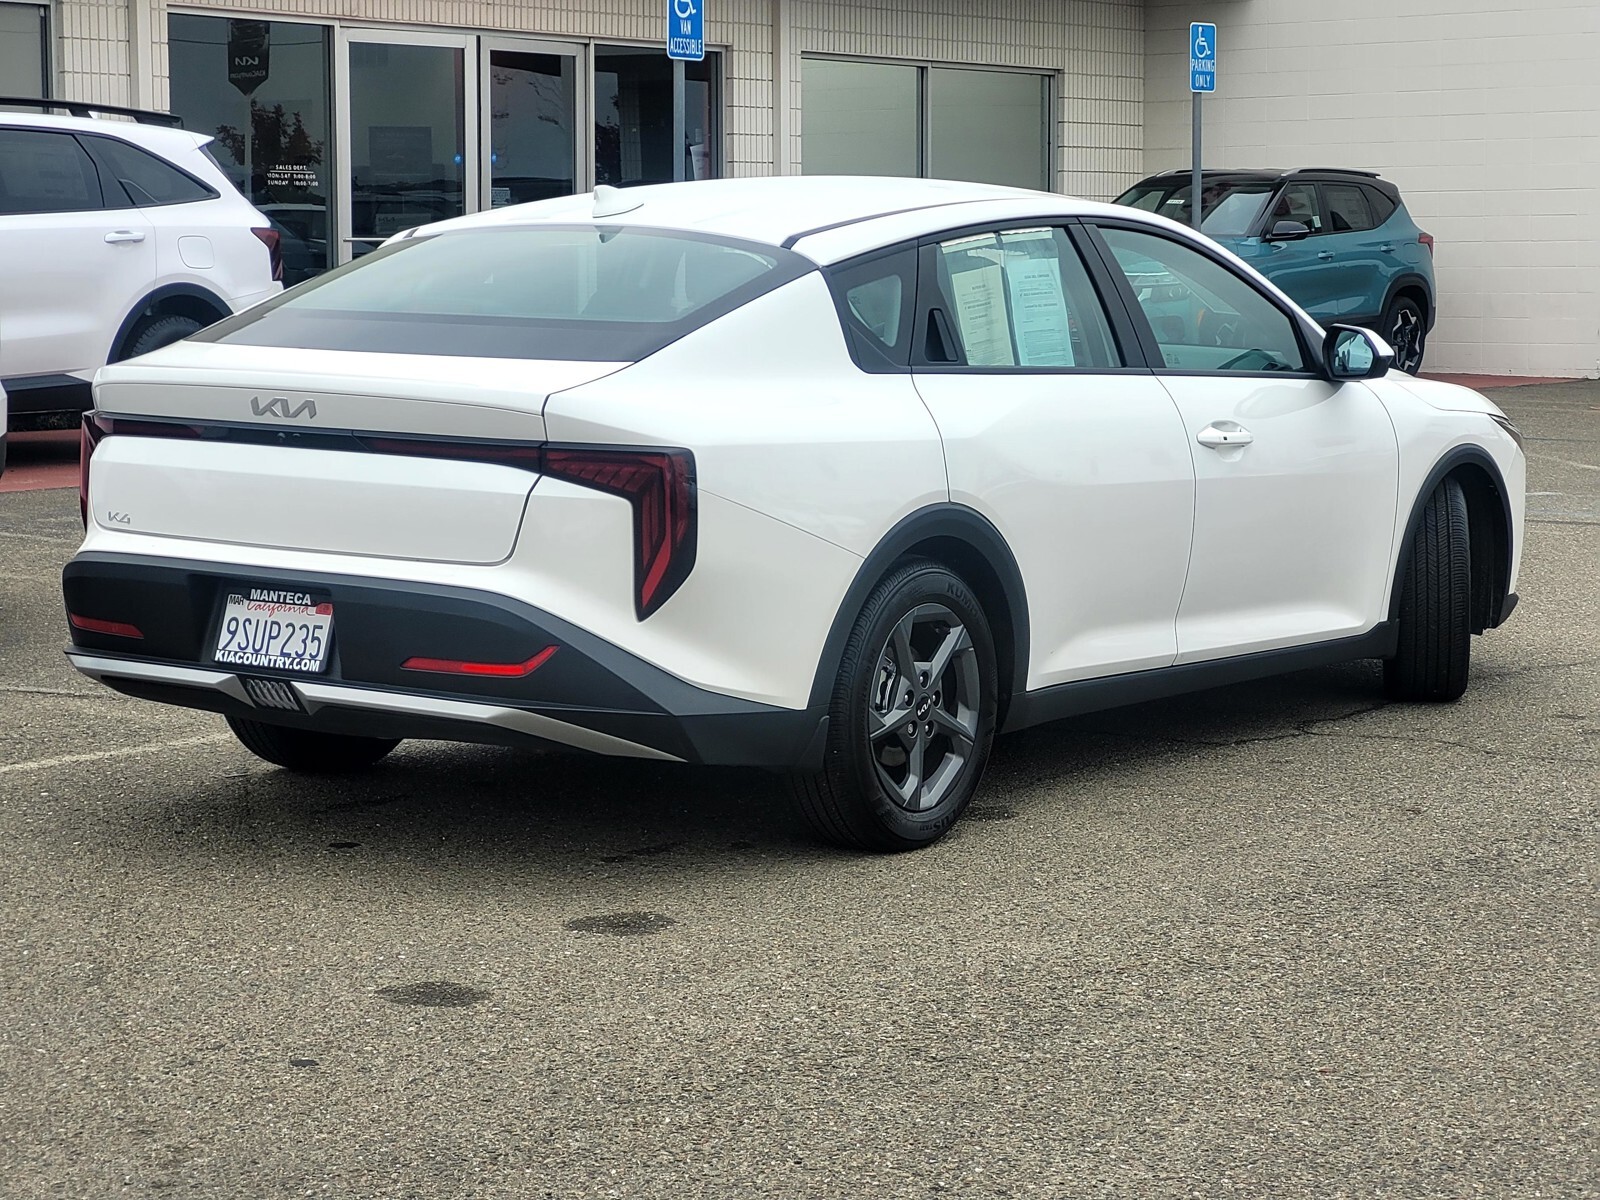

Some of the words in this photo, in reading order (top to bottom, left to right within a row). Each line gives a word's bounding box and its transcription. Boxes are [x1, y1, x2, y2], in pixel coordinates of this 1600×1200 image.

[680, 19, 692, 35] VAN
[669, 37, 702, 55] ACCESSIBLE
[1191, 58, 1215, 72] PARKING
[1195, 74, 1211, 87] ONLY
[250, 396, 317, 420] KIA
[108, 511, 131, 525] K4
[250, 589, 311, 605] MANTECA
[221, 616, 324, 660] 9SUP235
[214, 650, 320, 672] KIACOUNTRY.COM
[917, 698, 931, 716] KIA
